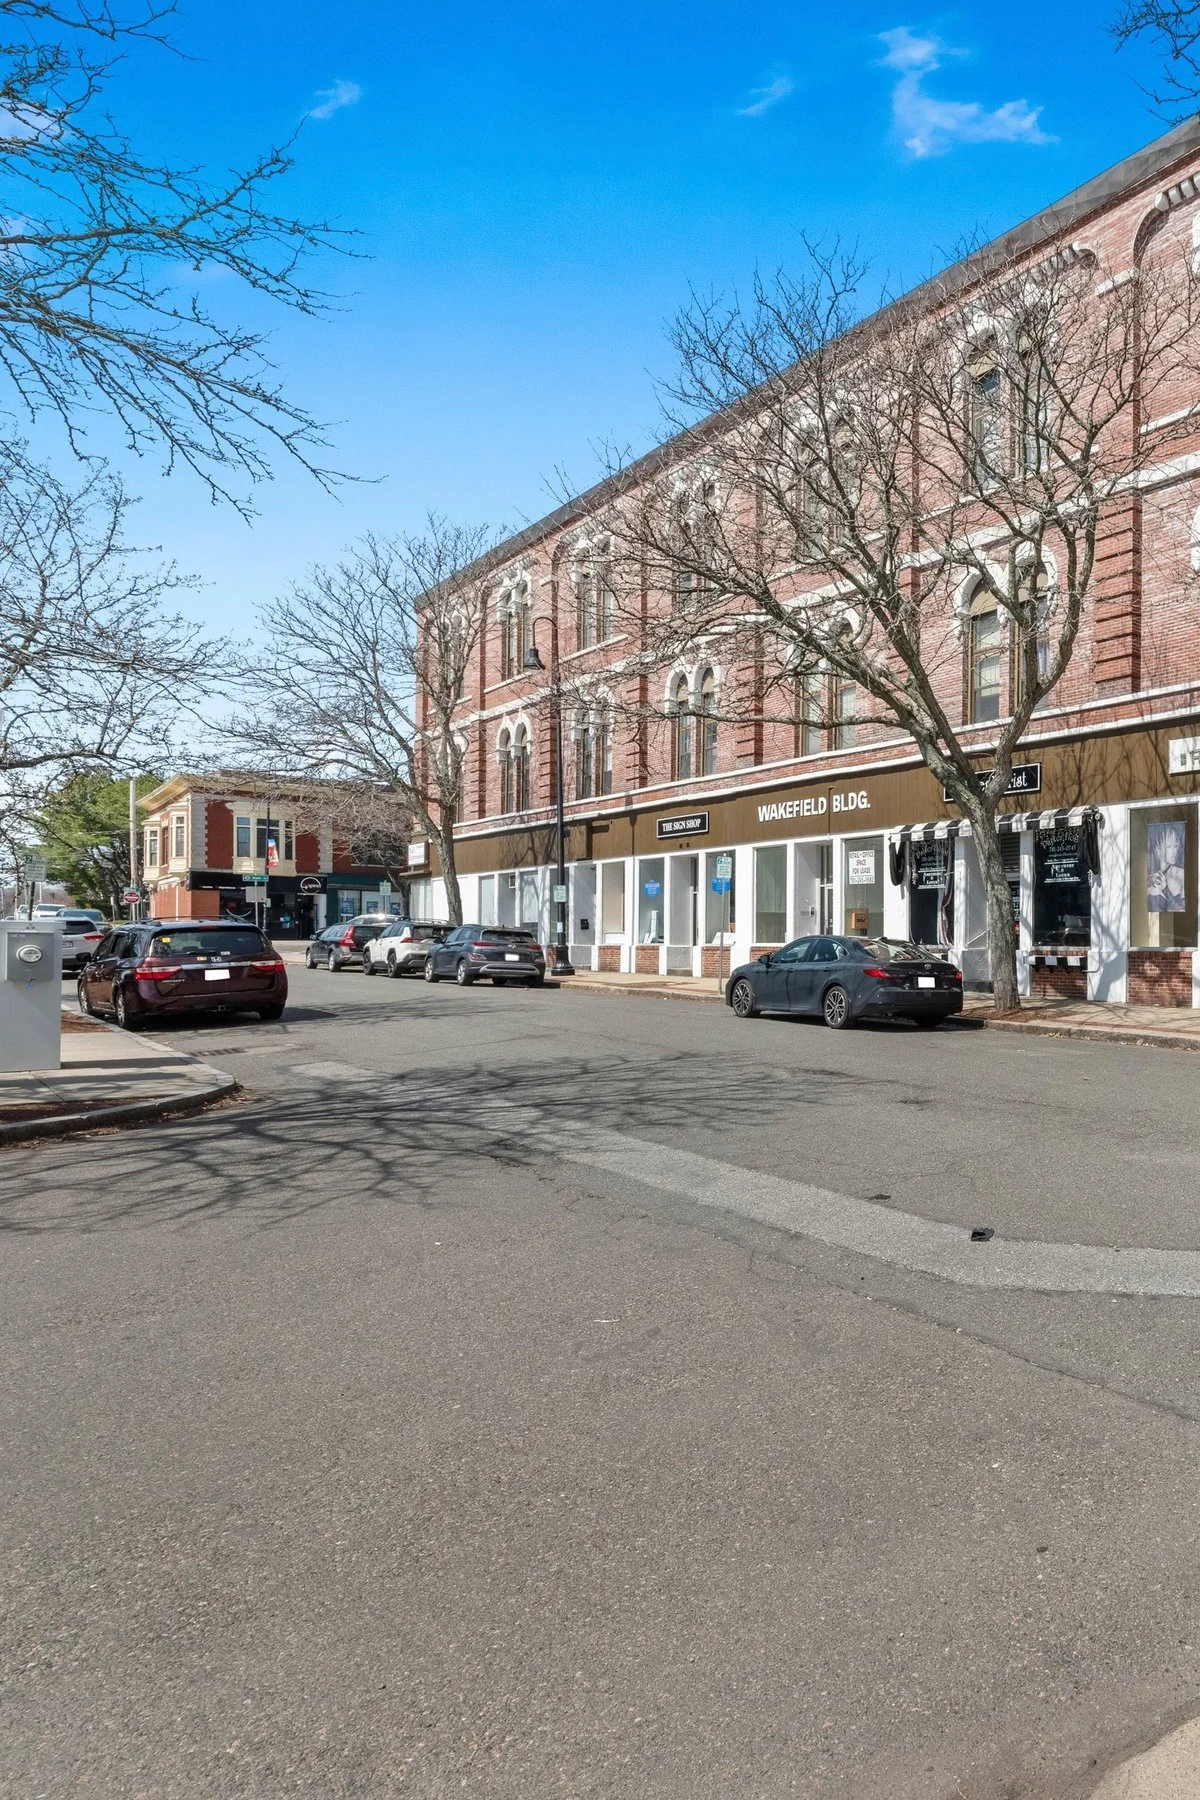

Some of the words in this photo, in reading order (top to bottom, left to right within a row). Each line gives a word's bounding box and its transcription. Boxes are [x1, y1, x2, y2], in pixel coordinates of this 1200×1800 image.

[758, 796, 827, 822] WAKEFIELD
[832, 791, 871, 813] BLDG.
[662, 823, 673, 832] THE
[673, 821, 686, 831] SIGN
[686, 818, 702, 829] SHOP
